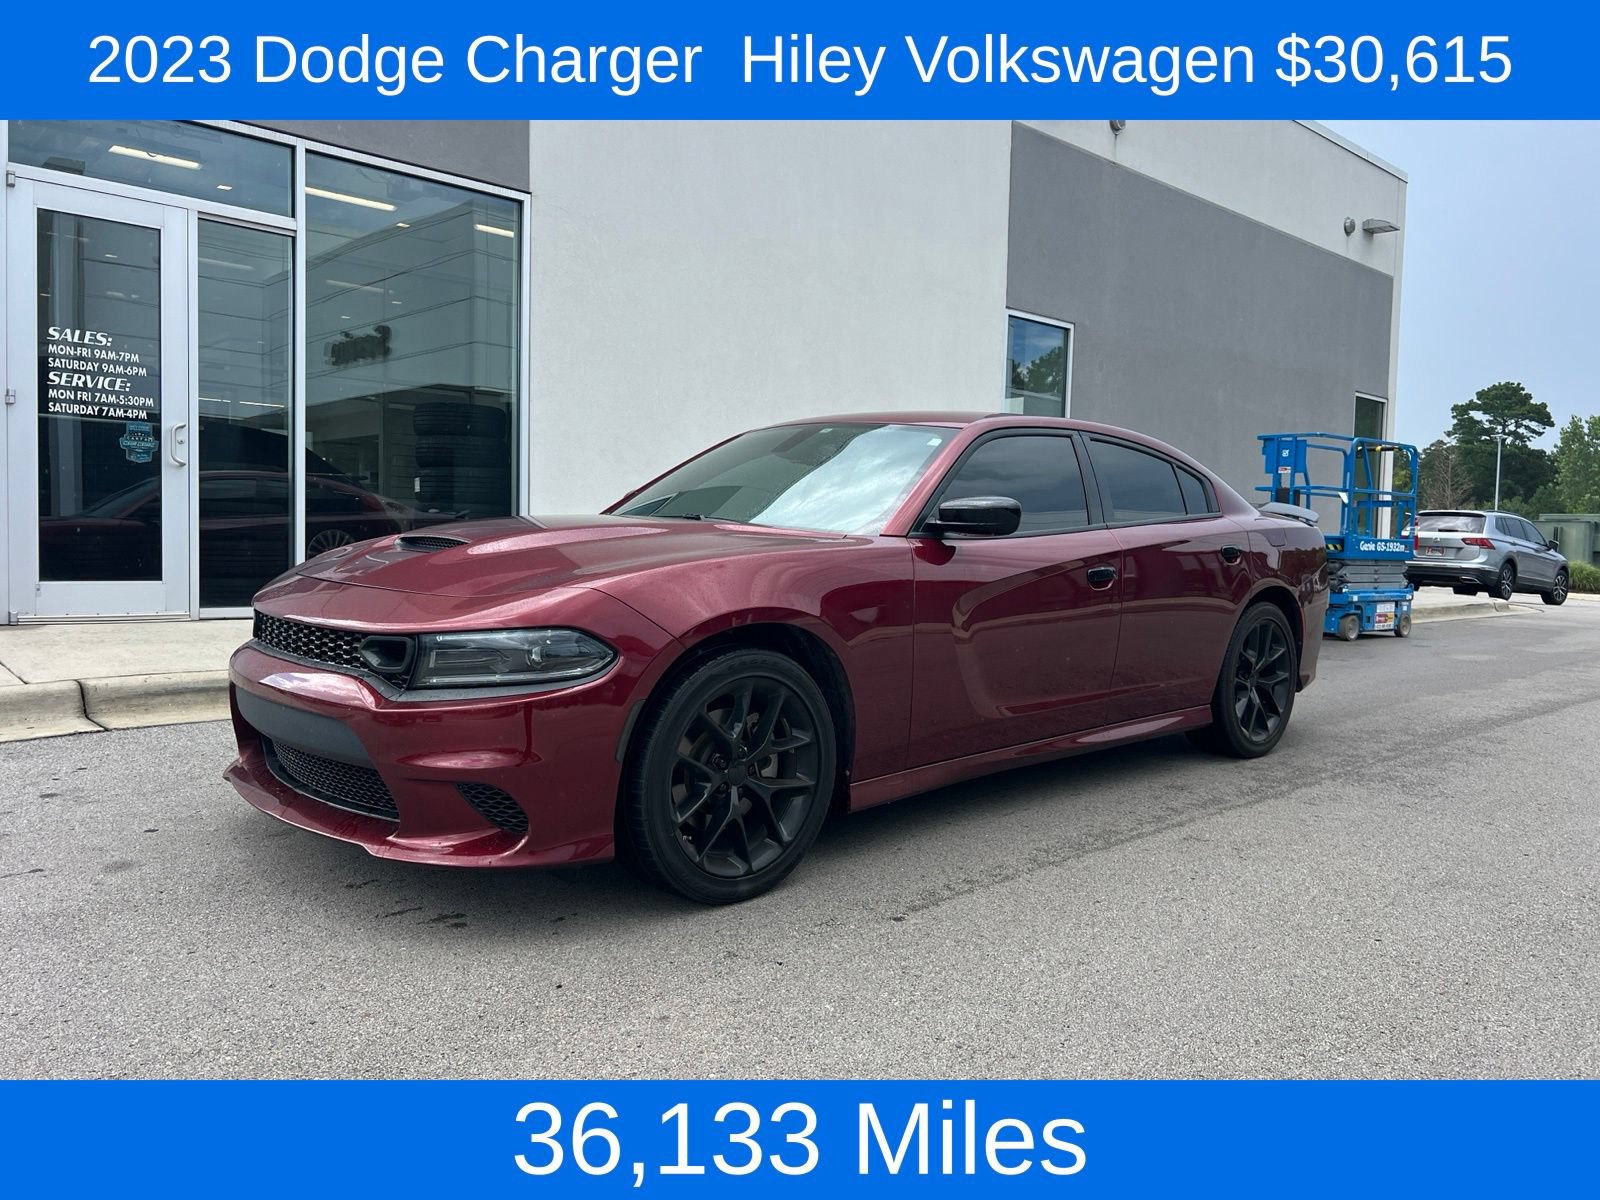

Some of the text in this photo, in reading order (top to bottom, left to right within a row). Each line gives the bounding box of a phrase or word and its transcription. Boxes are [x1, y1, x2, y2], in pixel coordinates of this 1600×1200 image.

[47, 326, 113, 346] SALES:
[48, 344, 139, 363] MON-FRI 9AM-7PM
[48, 357, 147, 377] SATURDAY 9AM-6PM
[47, 371, 131, 392] SERVICE:
[48, 389, 154, 407] MON FRI 7AM-5:30PM
[48, 402, 147, 420] SATURDAY 7AM-4PM
[1360, 541, 1376, 551] Genie
